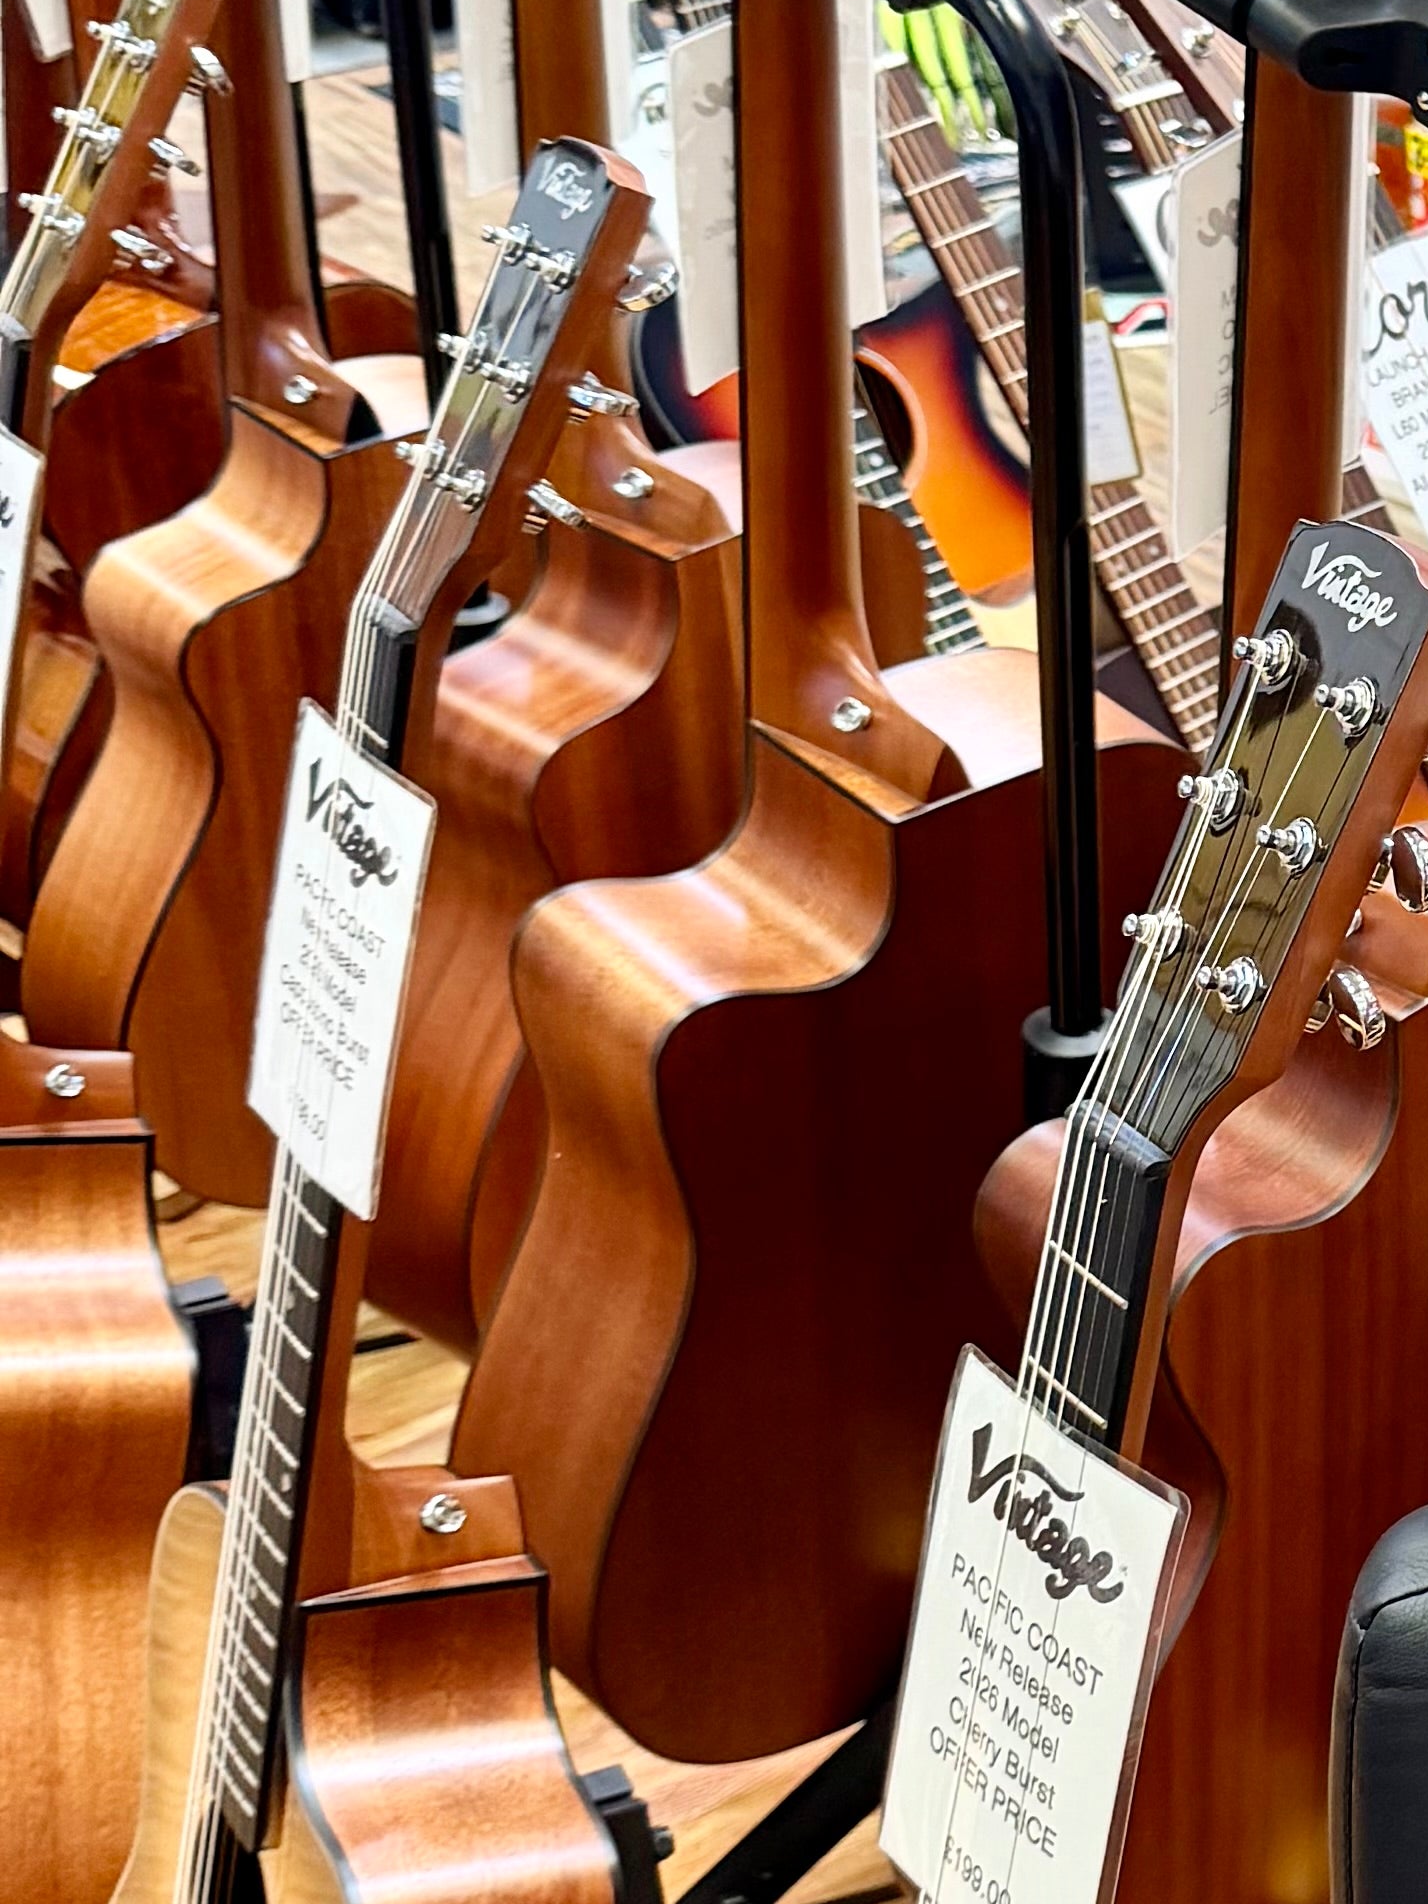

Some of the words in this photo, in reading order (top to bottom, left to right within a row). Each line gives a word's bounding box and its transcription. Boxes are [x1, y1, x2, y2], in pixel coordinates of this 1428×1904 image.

[537, 155, 594, 220] Vintage
[1367, 348, 1428, 388] LAUNCH
[1301, 541, 1398, 633] Vintage
[968, 1422, 1125, 1604] Vintage
[952, 1553, 1024, 1635] PACFIC
[1027, 1623, 1103, 1696] COAST
[960, 1608, 998, 1661] New
[999, 1647, 1074, 1725] Release
[1002, 1697, 1060, 1763] Model
[930, 1726, 988, 1802] OFFER
[991, 1785, 1058, 1858] PRICE
[1004, 1749, 1056, 1810] Burst
